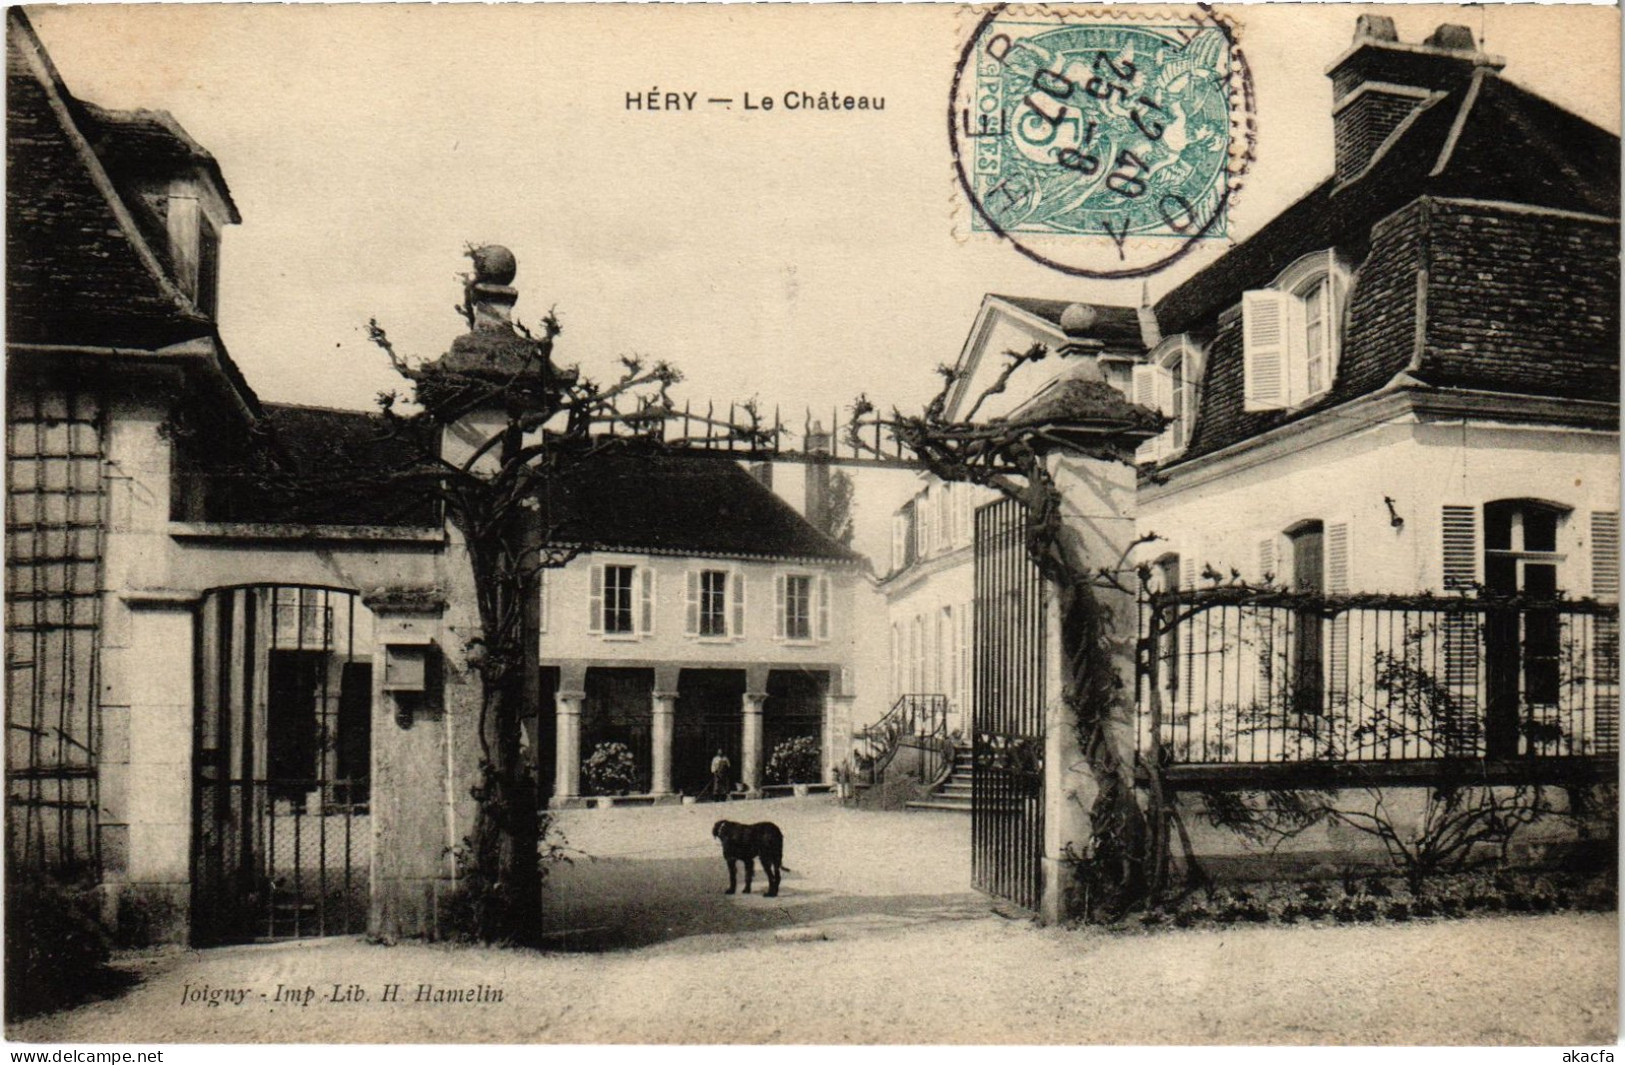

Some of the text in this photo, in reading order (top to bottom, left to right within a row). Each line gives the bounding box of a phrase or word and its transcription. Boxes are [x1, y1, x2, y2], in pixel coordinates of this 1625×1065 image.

[626, 86, 698, 110] HÉRY
[744, 92, 774, 110] Le
[783, 91, 886, 110] Château
[1023, 69, 1075, 127] 07
[1085, 51, 1137, 101] 25
[1018, 109, 1080, 158] 5
[1106, 149, 1150, 198] 40
[181, 983, 250, 1008] Joigny
[382, 984, 405, 1003] H.
[414, 983, 505, 1003] Hamelin
